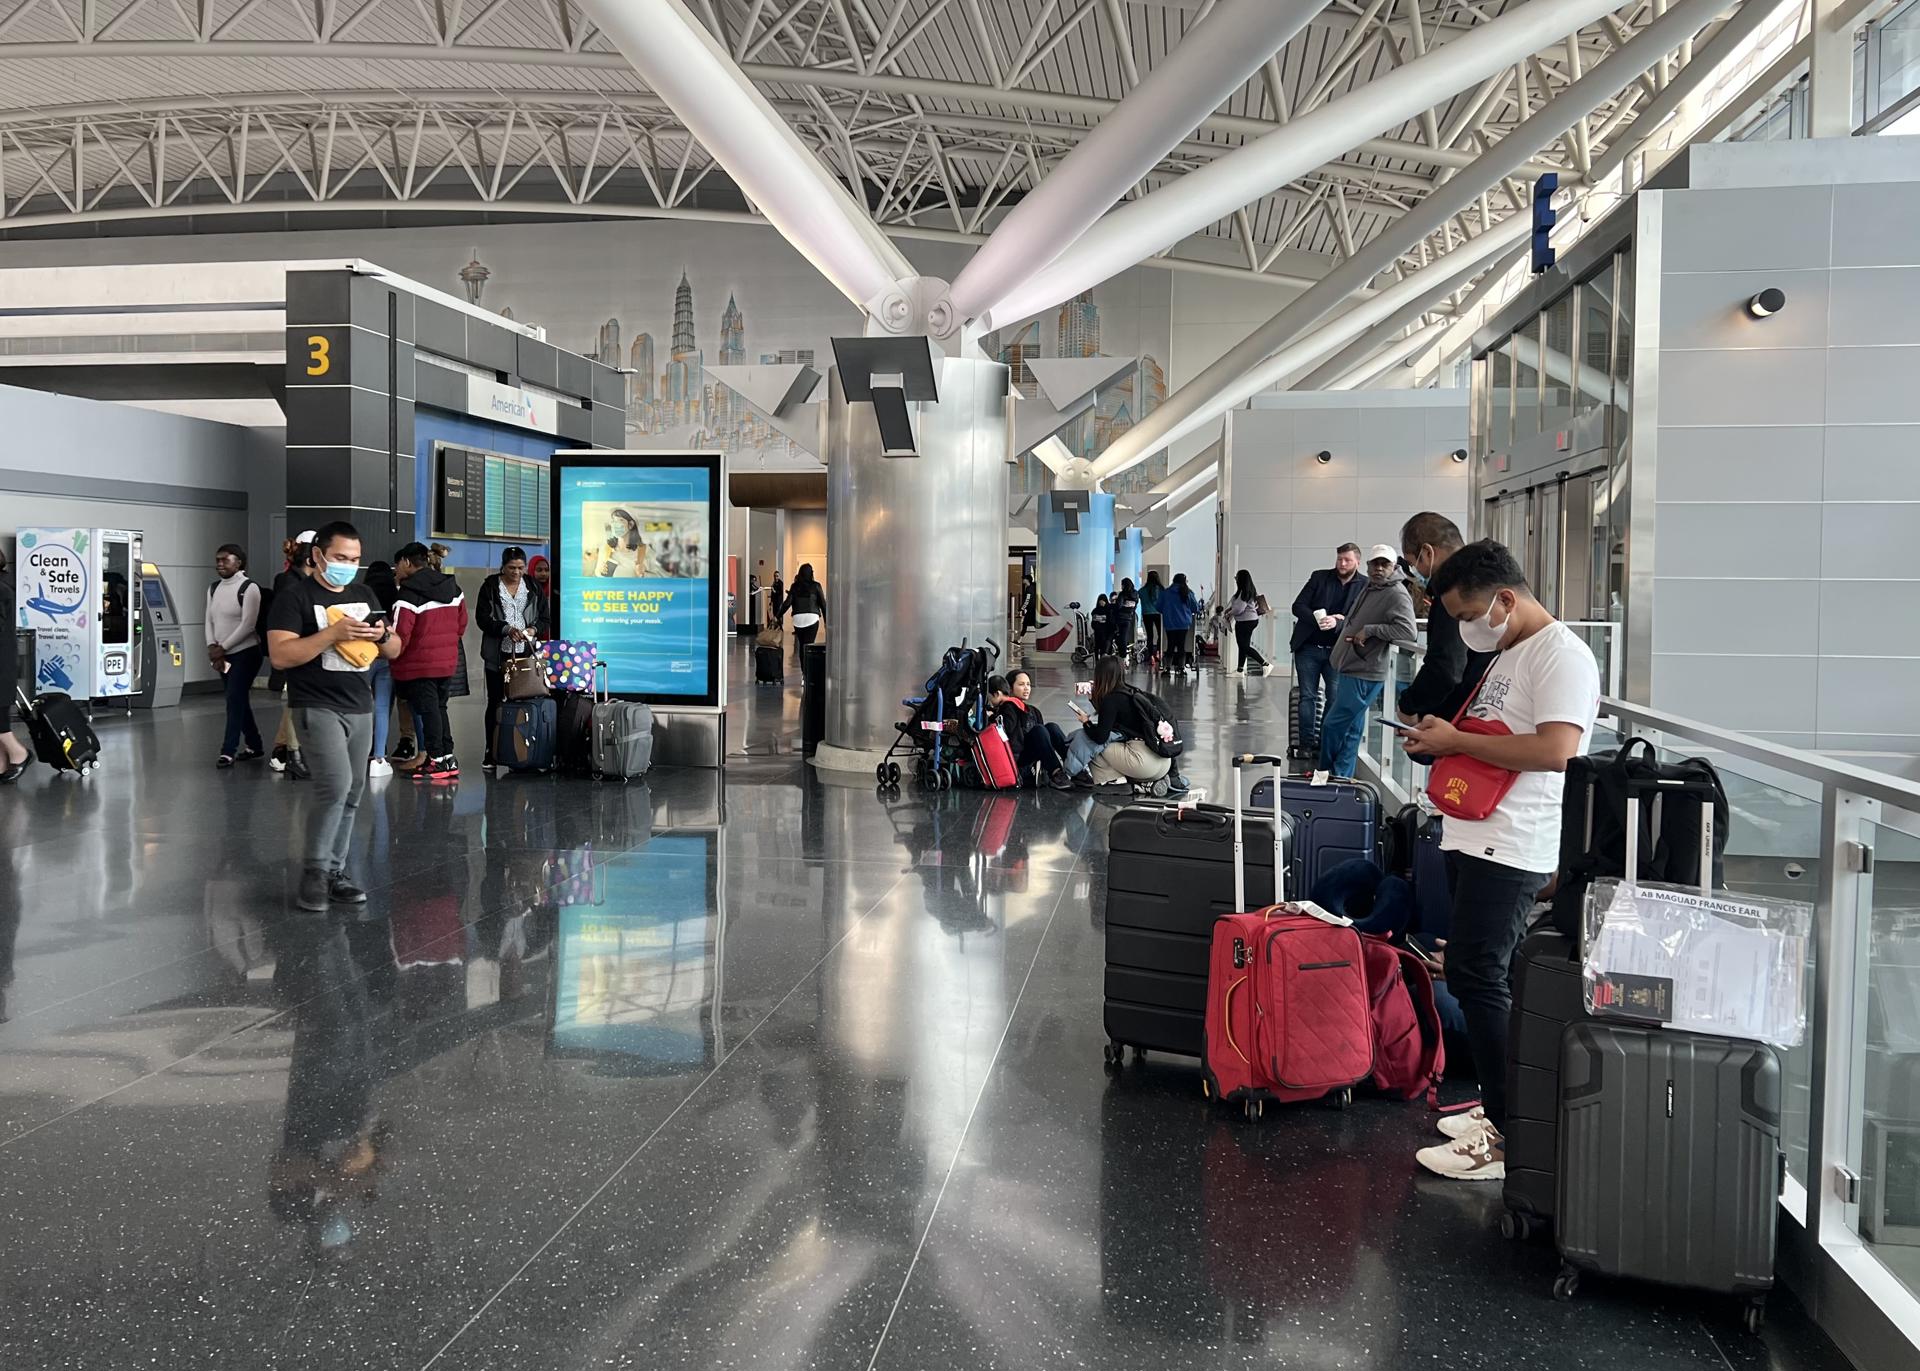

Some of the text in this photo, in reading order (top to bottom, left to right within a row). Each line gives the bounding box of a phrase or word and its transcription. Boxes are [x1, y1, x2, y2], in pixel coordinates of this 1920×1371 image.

[306, 335, 330, 376] 3
[491, 394, 526, 417] American
[30, 554, 69, 567] Clean
[40, 568, 79, 583] & Safe
[50, 585, 80, 594] Travels
[582, 590, 674, 601] WE'RE HAPPY
[583, 602, 660, 613] TO SEE YOU
[605, 617, 629, 625] wearing
[107, 659, 121, 669] PPE
[1640, 891, 1761, 918] AB MAGUAD FRANCIS EARL
